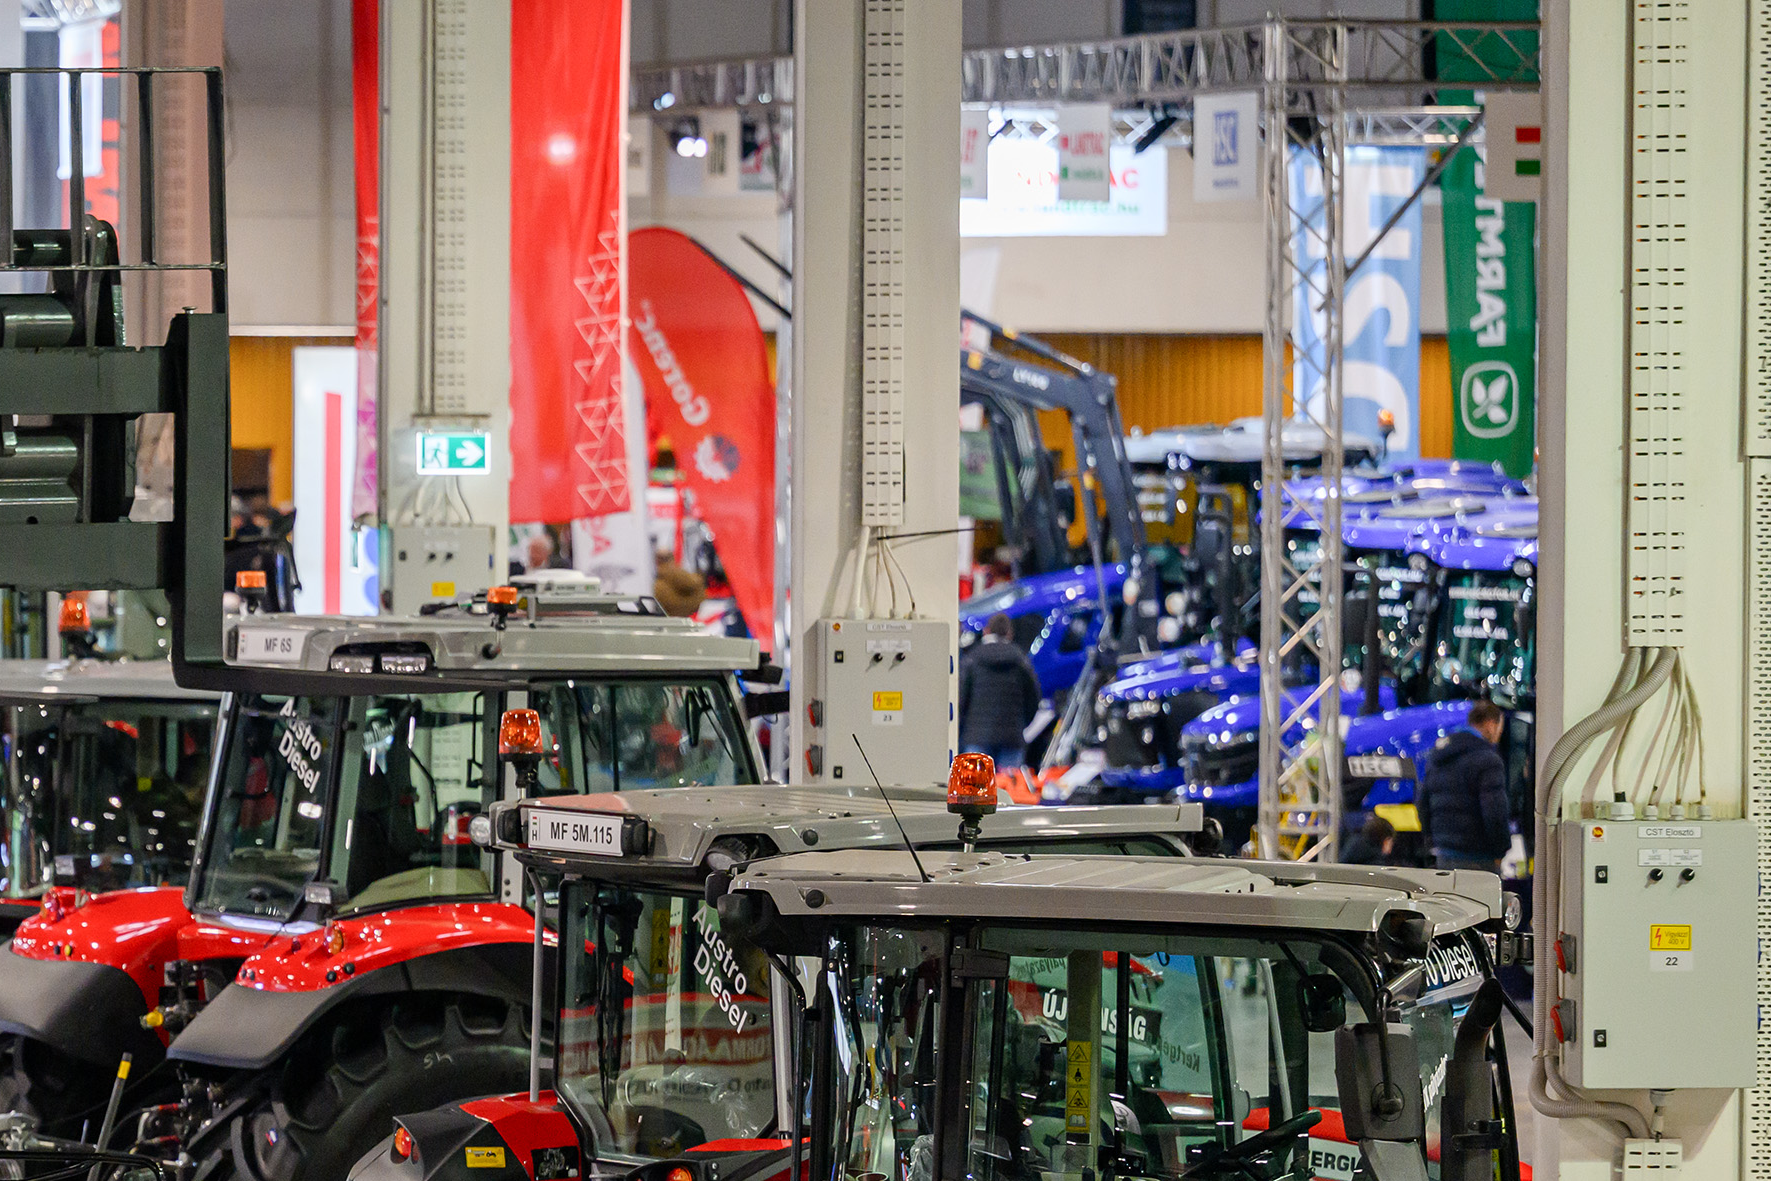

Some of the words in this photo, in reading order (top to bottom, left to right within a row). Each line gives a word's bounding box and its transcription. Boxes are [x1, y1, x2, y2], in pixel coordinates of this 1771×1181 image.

[264, 637, 278, 652] MF
[280, 698, 322, 761] Austro
[278, 729, 321, 794] Diesel
[549, 822, 570, 841] MF
[572, 823, 613, 845] 5M.115
[1645, 828, 1663, 836] CST
[692, 905, 747, 995] Austro
[1438, 941, 1478, 984] Diesel
[1665, 957, 1678, 966] 22
[693, 943, 748, 1034] Diesel
